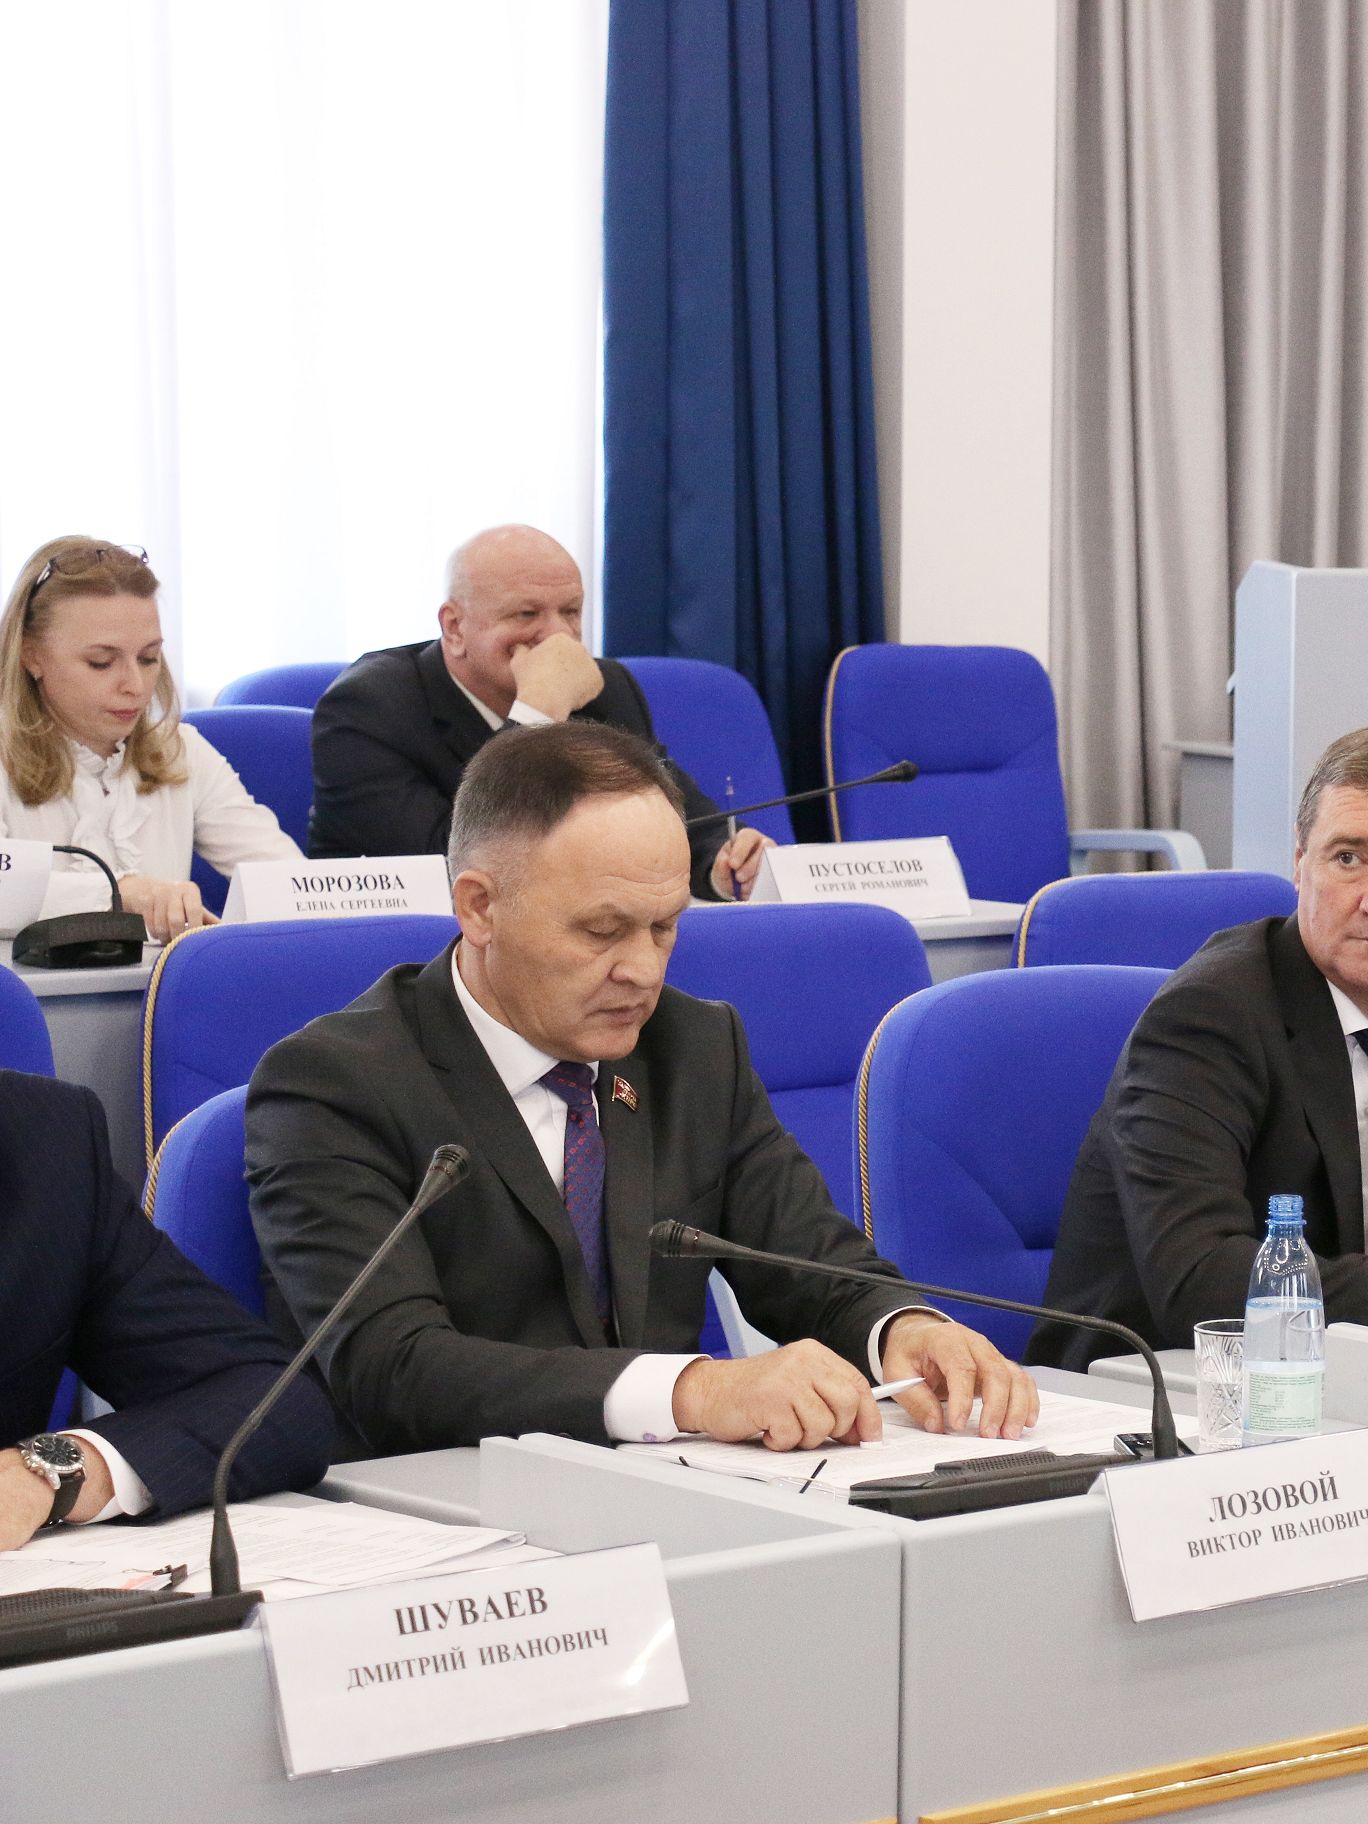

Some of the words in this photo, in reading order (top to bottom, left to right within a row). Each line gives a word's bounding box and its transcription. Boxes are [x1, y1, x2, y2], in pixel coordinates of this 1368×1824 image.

[808, 859, 923, 877] ПУСТОСЕЛОВ
[291, 874, 405, 893] МОРОЗОВА
[814, 881, 857, 892] СЕРГЕЙ
[860, 878, 929, 890] РОМАНОВИЧ
[296, 900, 336, 912] ЕЛЕНА
[340, 898, 408, 910] СЕРГЕЕВНА
[1208, 1470, 1340, 1523] ЛОЗОВОЙ
[1187, 1528, 1262, 1559] ВИКТОР
[393, 1586, 549, 1636] ШУВАЕВ
[346, 1647, 467, 1692] ДМИТРИЙ
[479, 1627, 609, 1667] ИВАНОВИЧ
